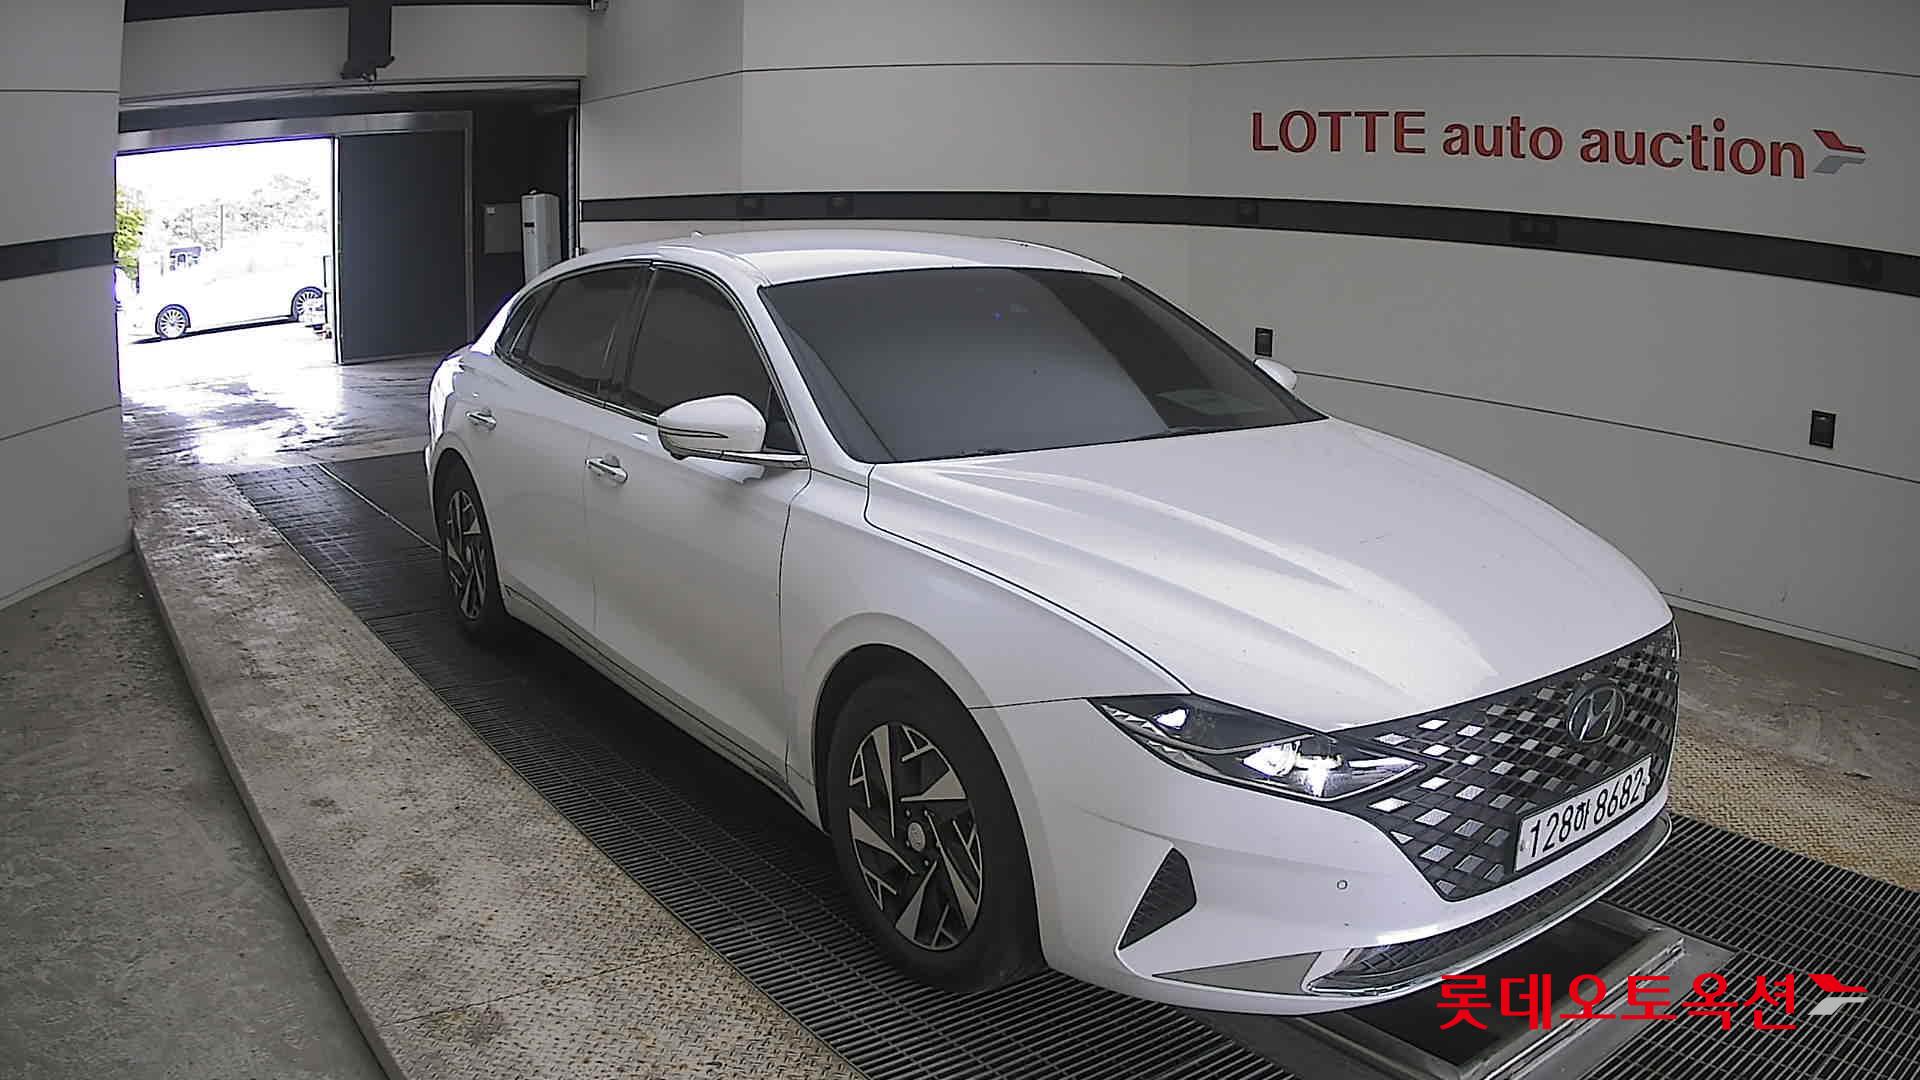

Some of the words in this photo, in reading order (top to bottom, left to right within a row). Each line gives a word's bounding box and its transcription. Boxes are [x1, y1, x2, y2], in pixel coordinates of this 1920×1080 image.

[1251, 111, 1426, 153] LOTTE
[1443, 116, 1563, 160] auto
[1579, 118, 1806, 179] auction
[1530, 799, 1590, 857] 128하
[1593, 767, 1643, 825] 8682
